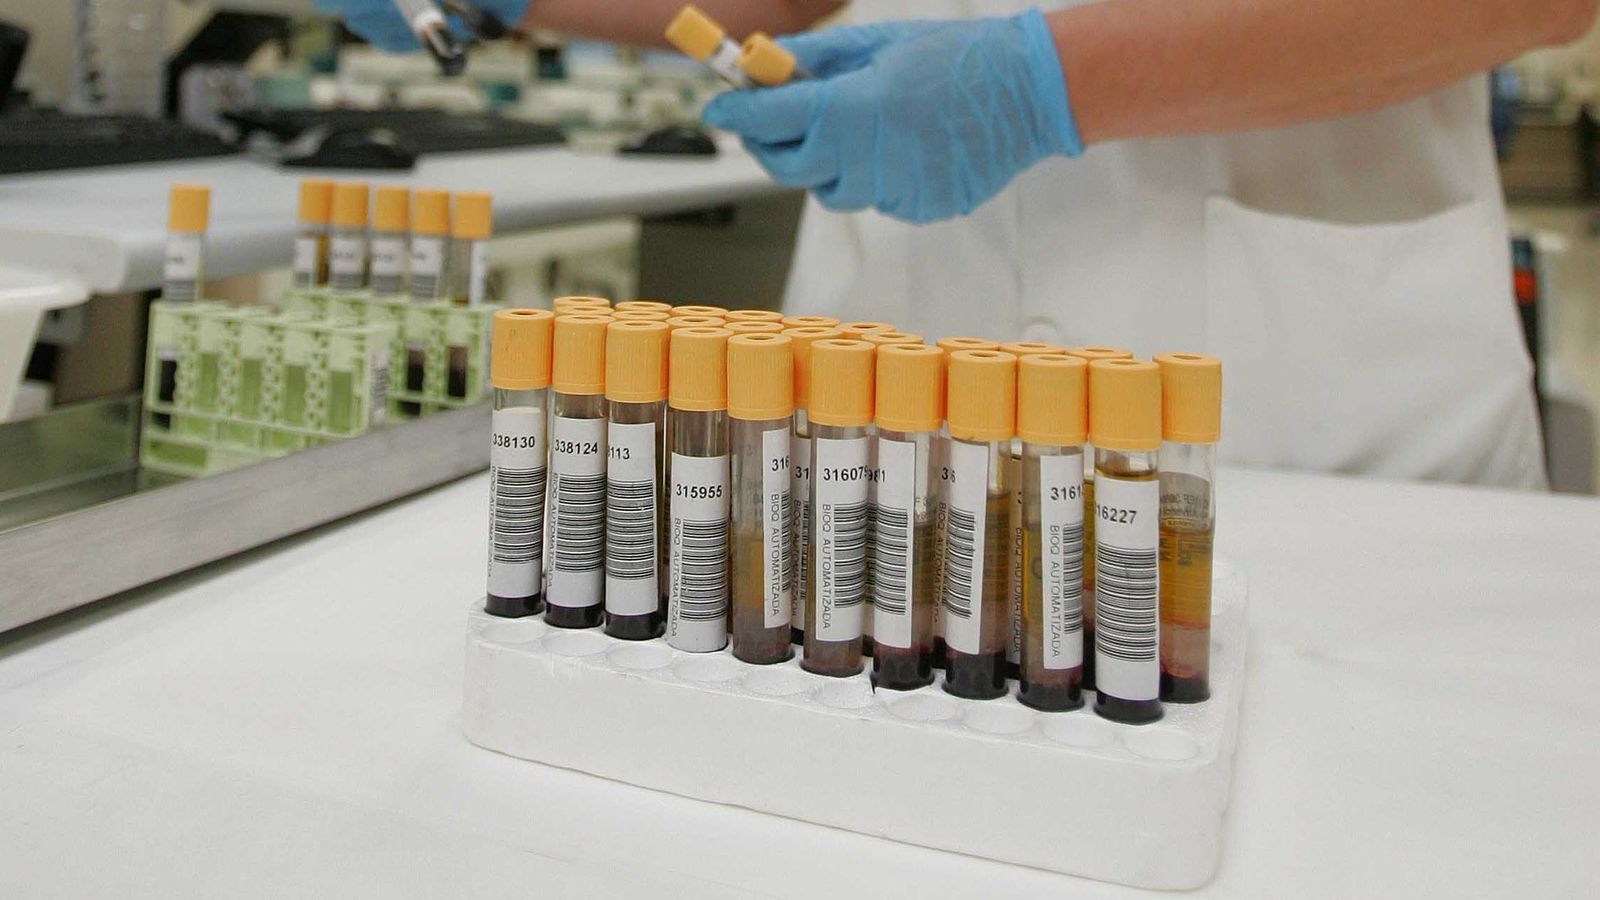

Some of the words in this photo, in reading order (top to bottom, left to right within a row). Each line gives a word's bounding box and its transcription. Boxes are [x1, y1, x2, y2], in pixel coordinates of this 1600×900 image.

[493, 433, 536, 449] 338130
[554, 439, 599, 455] 338124
[675, 483, 722, 499] 315955
[771, 493, 780, 522] BIOQ
[822, 503, 832, 533] BIOQ
[674, 517, 682, 546] BIOQ
[1050, 524, 1060, 556] BIOQ
[771, 527, 781, 617] AUTOMATIZADA
[821, 539, 832, 629] AUTOMATIZADA
[671, 550, 680, 637] AUTOMATIZADA
[1050, 560, 1062, 658] AUTOMATIZADA
